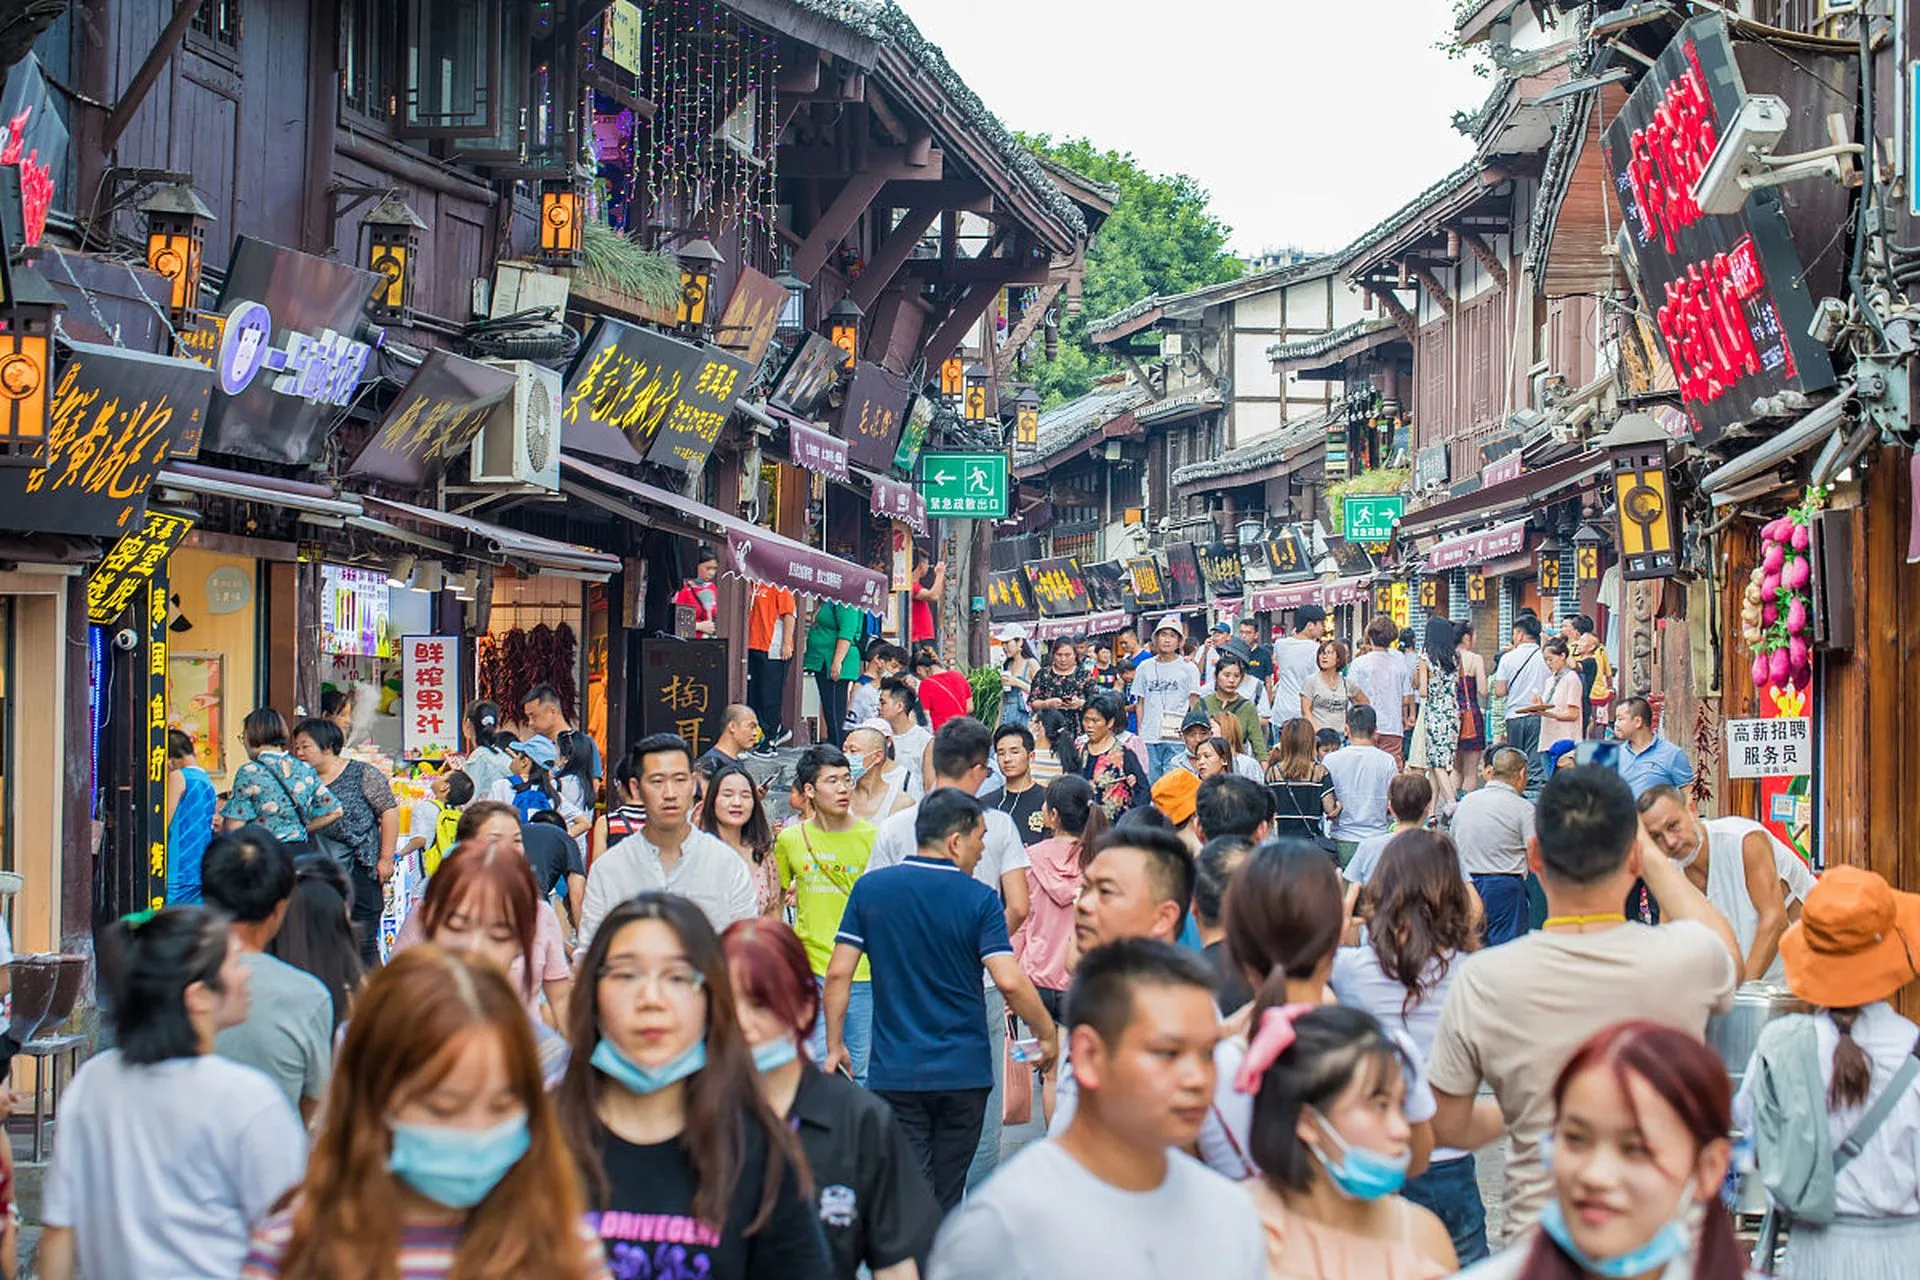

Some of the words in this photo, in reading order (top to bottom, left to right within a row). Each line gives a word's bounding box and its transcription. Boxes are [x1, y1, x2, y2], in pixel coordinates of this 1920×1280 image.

[413, 642, 445, 735] 鲜榨果汁
[1733, 720, 1807, 742] 高薪招聘
[1744, 744, 1798, 766] 服务员
